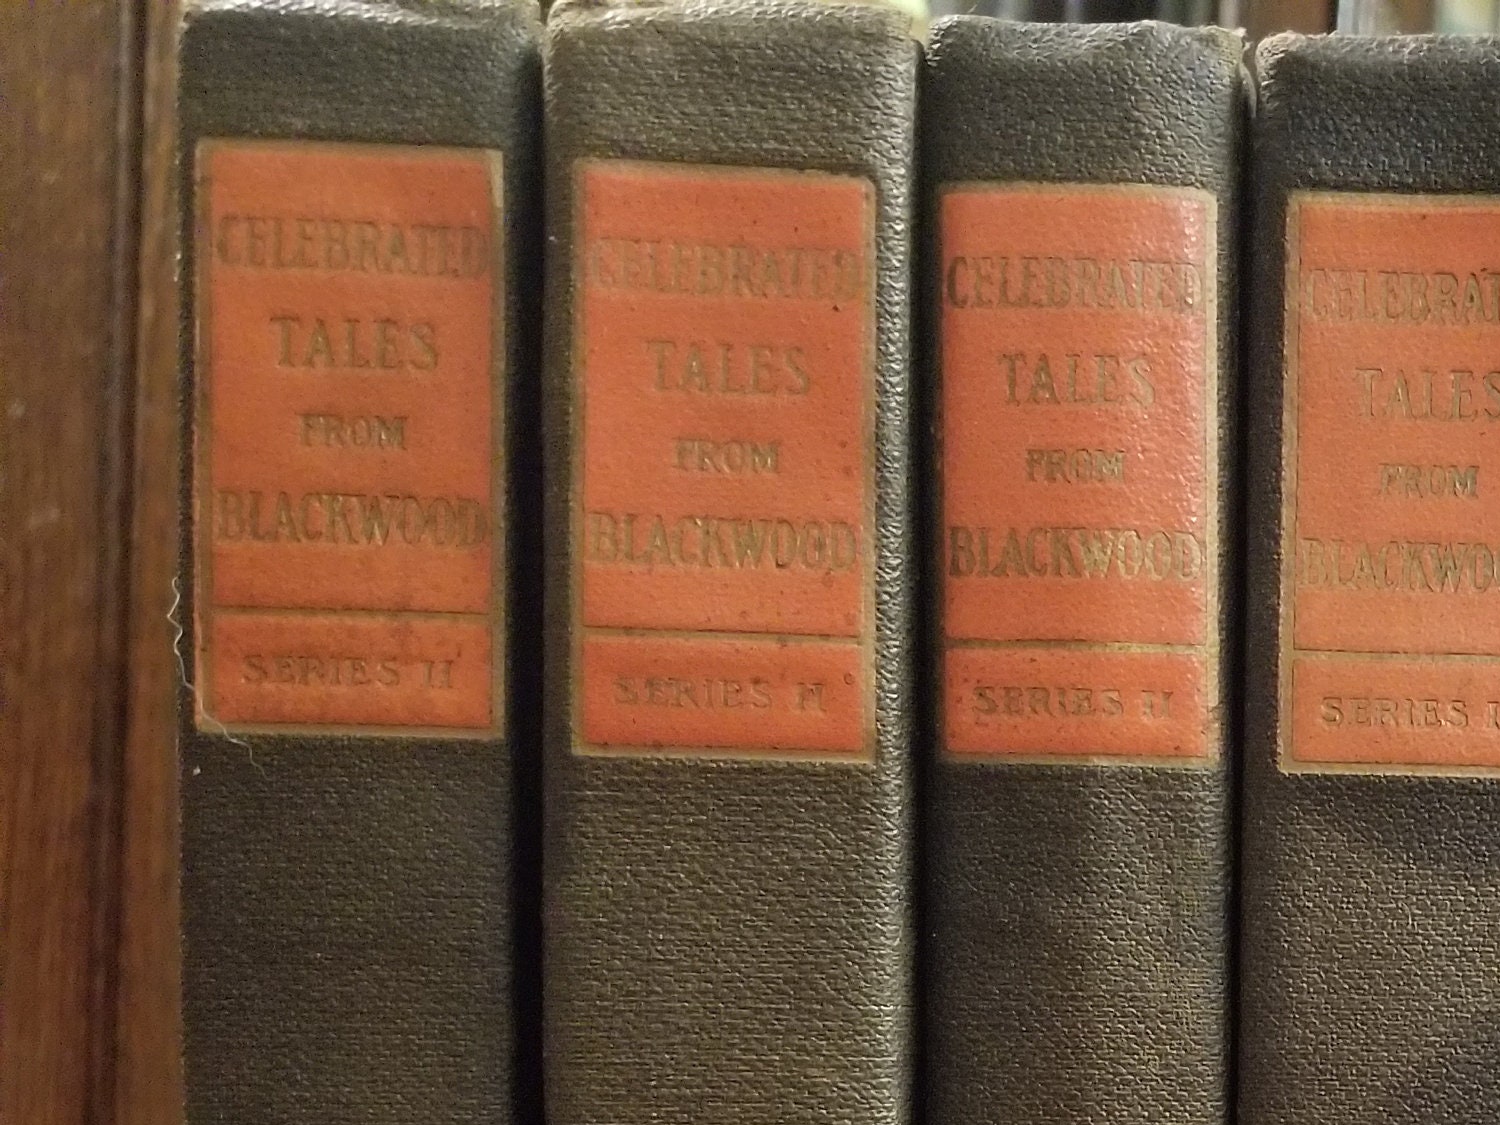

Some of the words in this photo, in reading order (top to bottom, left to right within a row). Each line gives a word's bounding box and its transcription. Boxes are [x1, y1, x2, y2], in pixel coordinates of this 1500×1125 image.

[216, 215, 489, 280] CELEBRATED
[591, 236, 861, 300] CELEBRATED
[946, 256, 1200, 313] CELEBRATED
[270, 316, 440, 371] TALES
[646, 340, 812, 396] TALES
[999, 352, 1156, 409] TALES
[297, 412, 409, 451] FROM
[672, 437, 782, 475] FROM
[1025, 448, 1125, 485] FROM
[1377, 463, 1479, 499] FROM
[216, 490, 490, 551] BLACKWOOD
[587, 511, 858, 572] BLACKWOOD
[949, 526, 1200, 582] BLACKWOOD
[241, 653, 400, 689] SERIES
[613, 677, 772, 710] SERIES
[973, 685, 1123, 719] SERIES
[1320, 696, 1468, 730] SERIES
